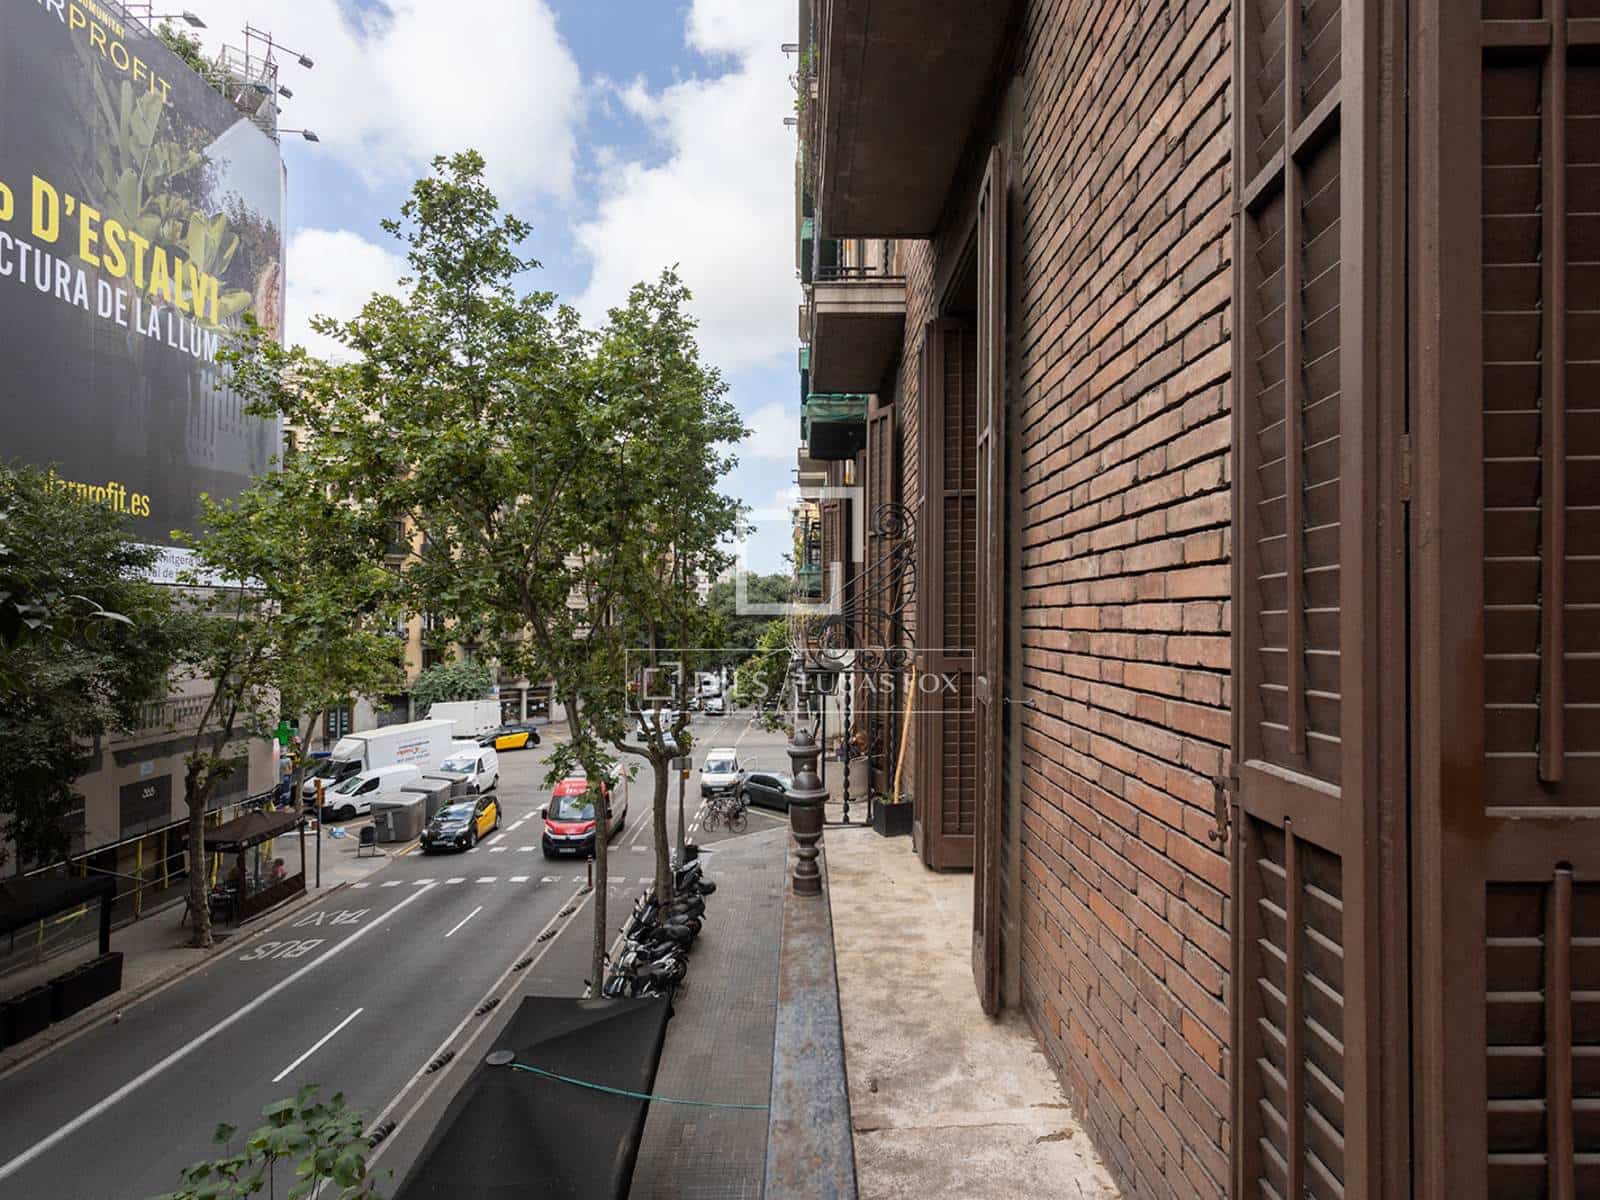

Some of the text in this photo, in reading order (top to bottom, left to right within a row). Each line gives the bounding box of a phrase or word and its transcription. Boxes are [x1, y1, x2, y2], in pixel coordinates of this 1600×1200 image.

[97, 279, 128, 327] DE
[136, 297, 161, 341] LA
[167, 312, 219, 366] LLUM
